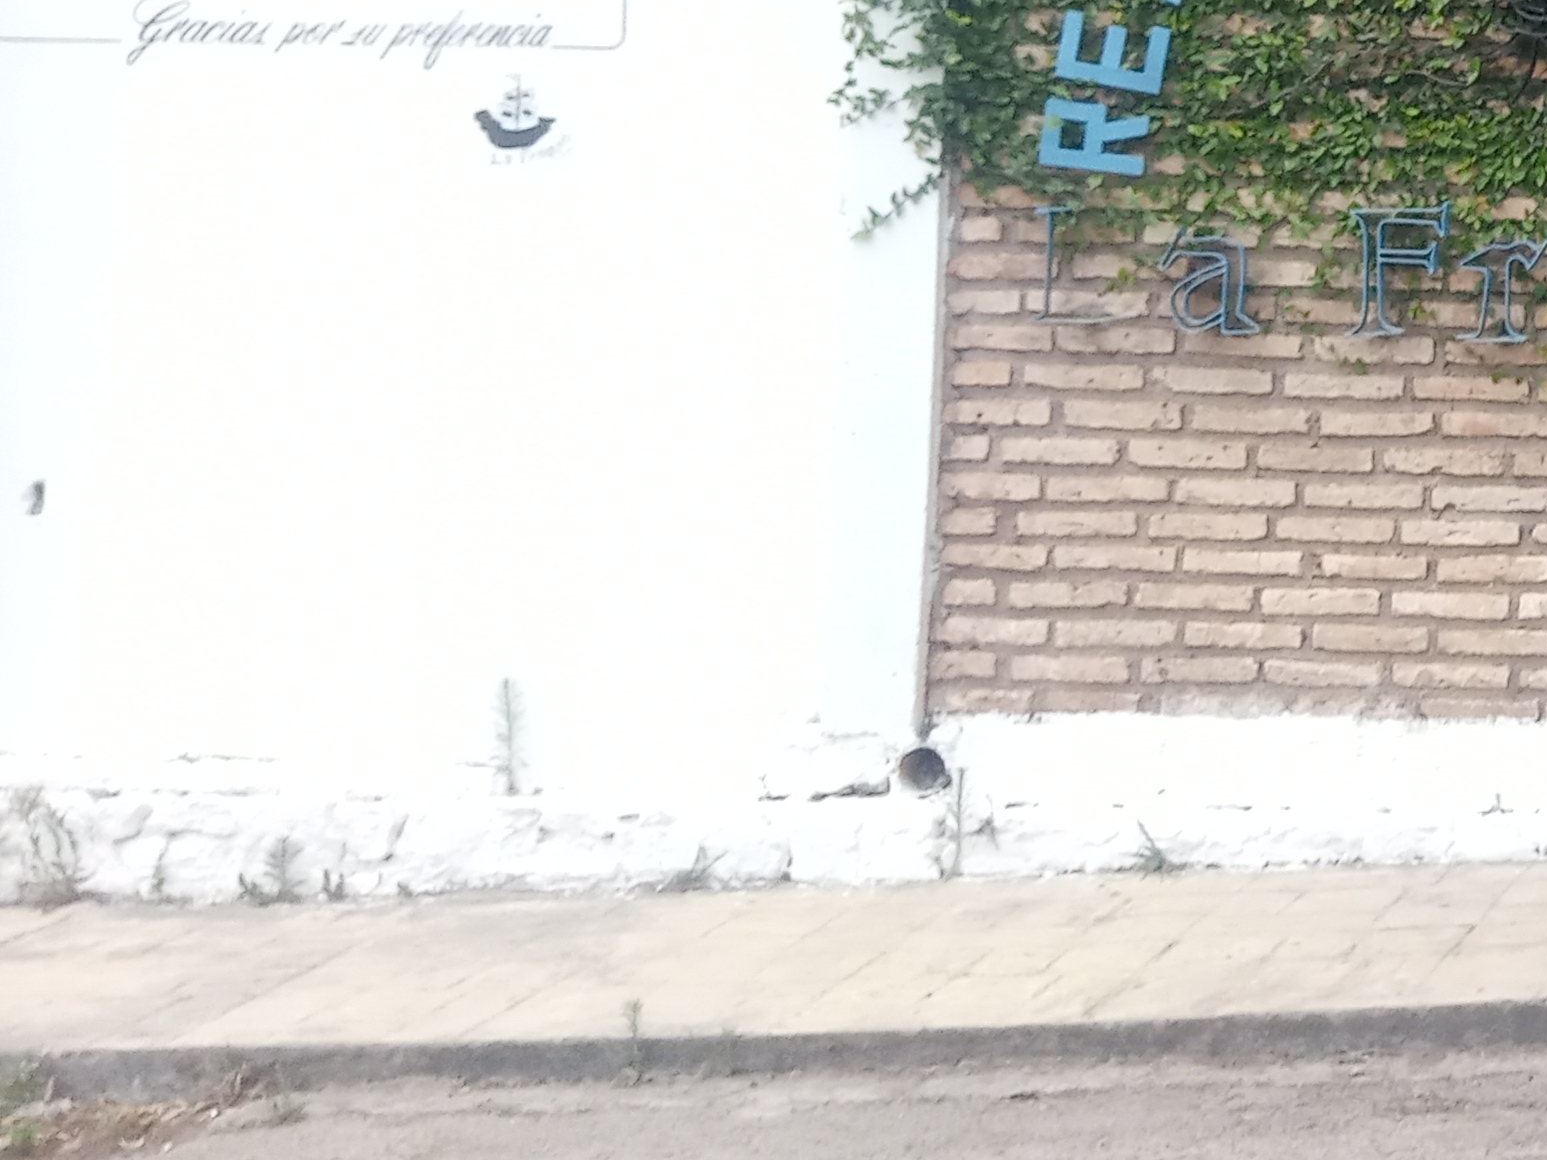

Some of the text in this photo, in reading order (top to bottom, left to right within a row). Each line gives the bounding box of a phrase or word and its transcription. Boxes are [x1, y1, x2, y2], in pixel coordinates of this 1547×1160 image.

[274, 19, 347, 53] por
[340, 23, 387, 46] su
[379, 9, 553, 70] preferencia
[1035, 203, 1260, 337] La
